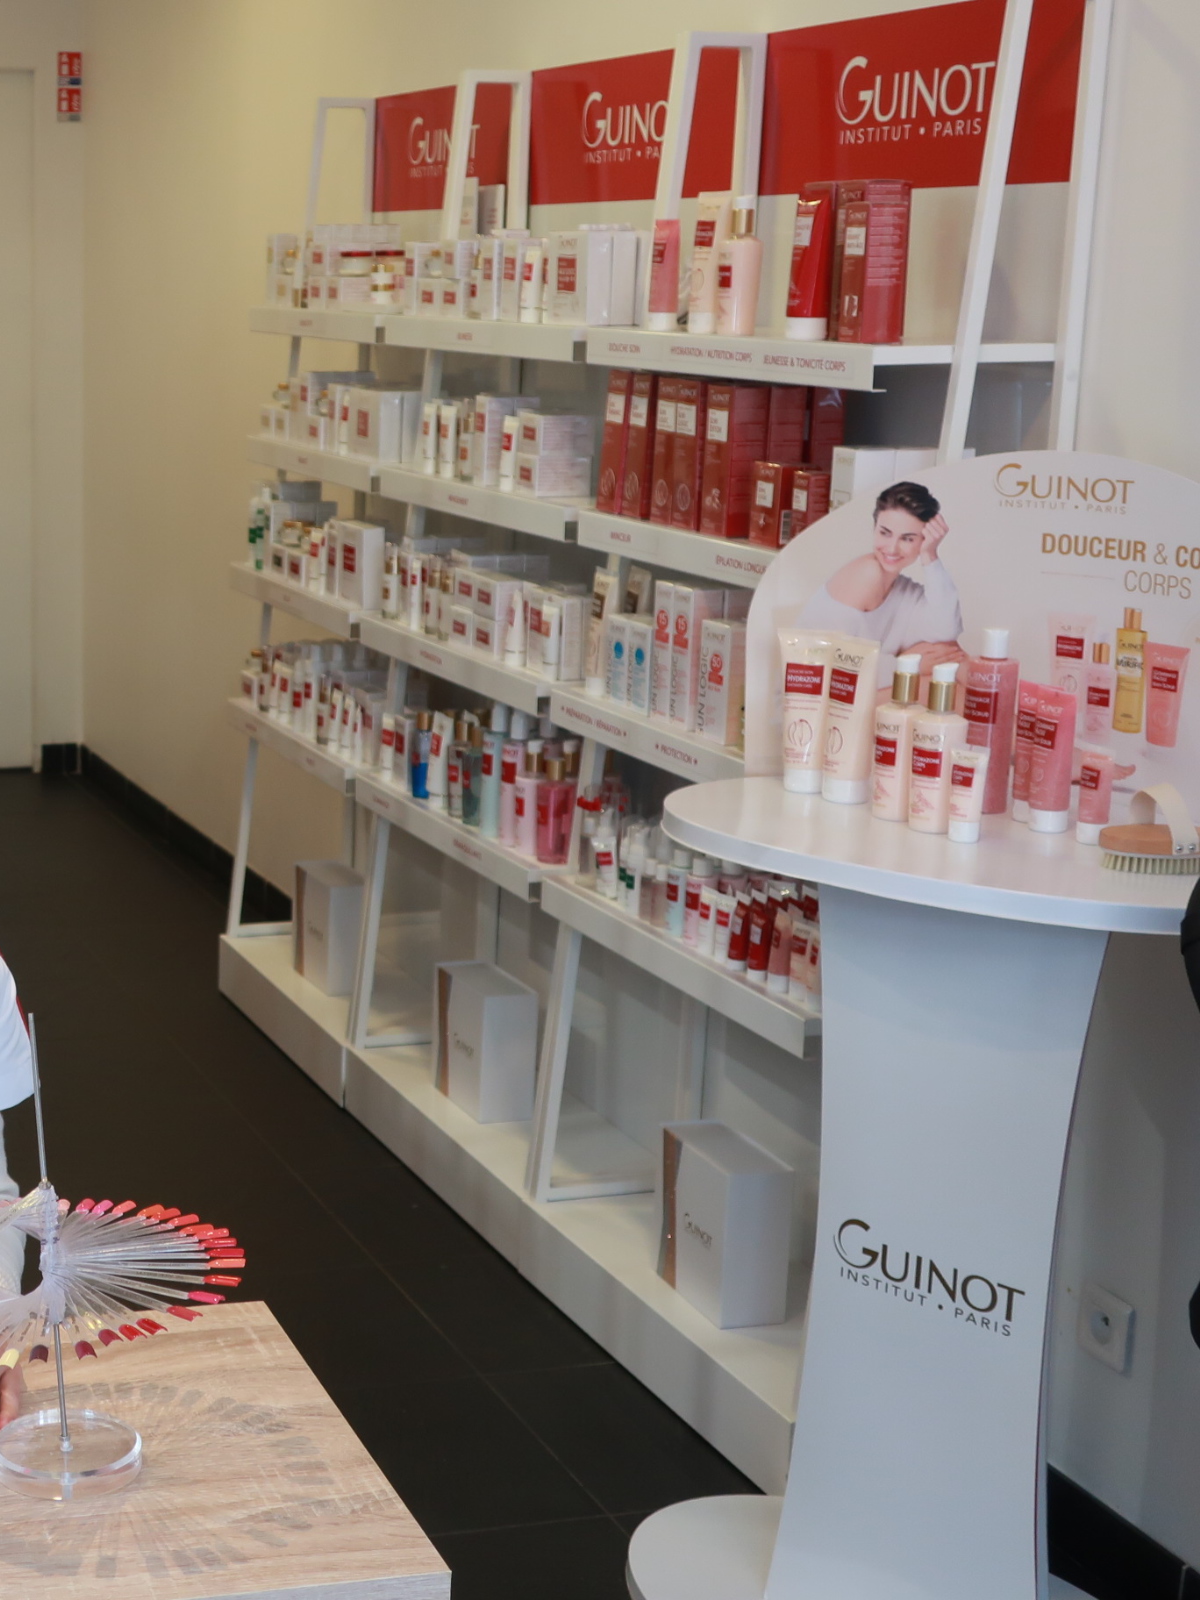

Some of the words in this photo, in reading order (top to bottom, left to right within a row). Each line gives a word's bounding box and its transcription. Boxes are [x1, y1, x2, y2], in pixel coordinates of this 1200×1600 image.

[835, 55, 996, 125] GUINOT
[582, 91, 668, 148] GUINO
[839, 124, 912, 145] INSTITUT
[933, 118, 982, 138] PARIS
[408, 116, 481, 165] GUINT
[585, 147, 632, 164] INSTITUT
[824, 360, 847, 372] CORPS
[993, 463, 1135, 504] GUINOT
[1000, 499, 1066, 511] INSTITUT
[1086, 503, 1127, 515] PARIS
[1041, 532, 1147, 562] DOUCEUR
[1153, 543, 1168, 566] &
[1124, 570, 1192, 600] CORPS
[678, 618, 686, 630] 15
[700, 647, 710, 698] LOGIC
[711, 656, 721, 668] 50
[787, 675, 821, 684] HYDRAZONE
[833, 1218, 1025, 1322] GUINOT
[840, 1266, 928, 1307] INSTITUT
[954, 1307, 1012, 1337] PARIS
